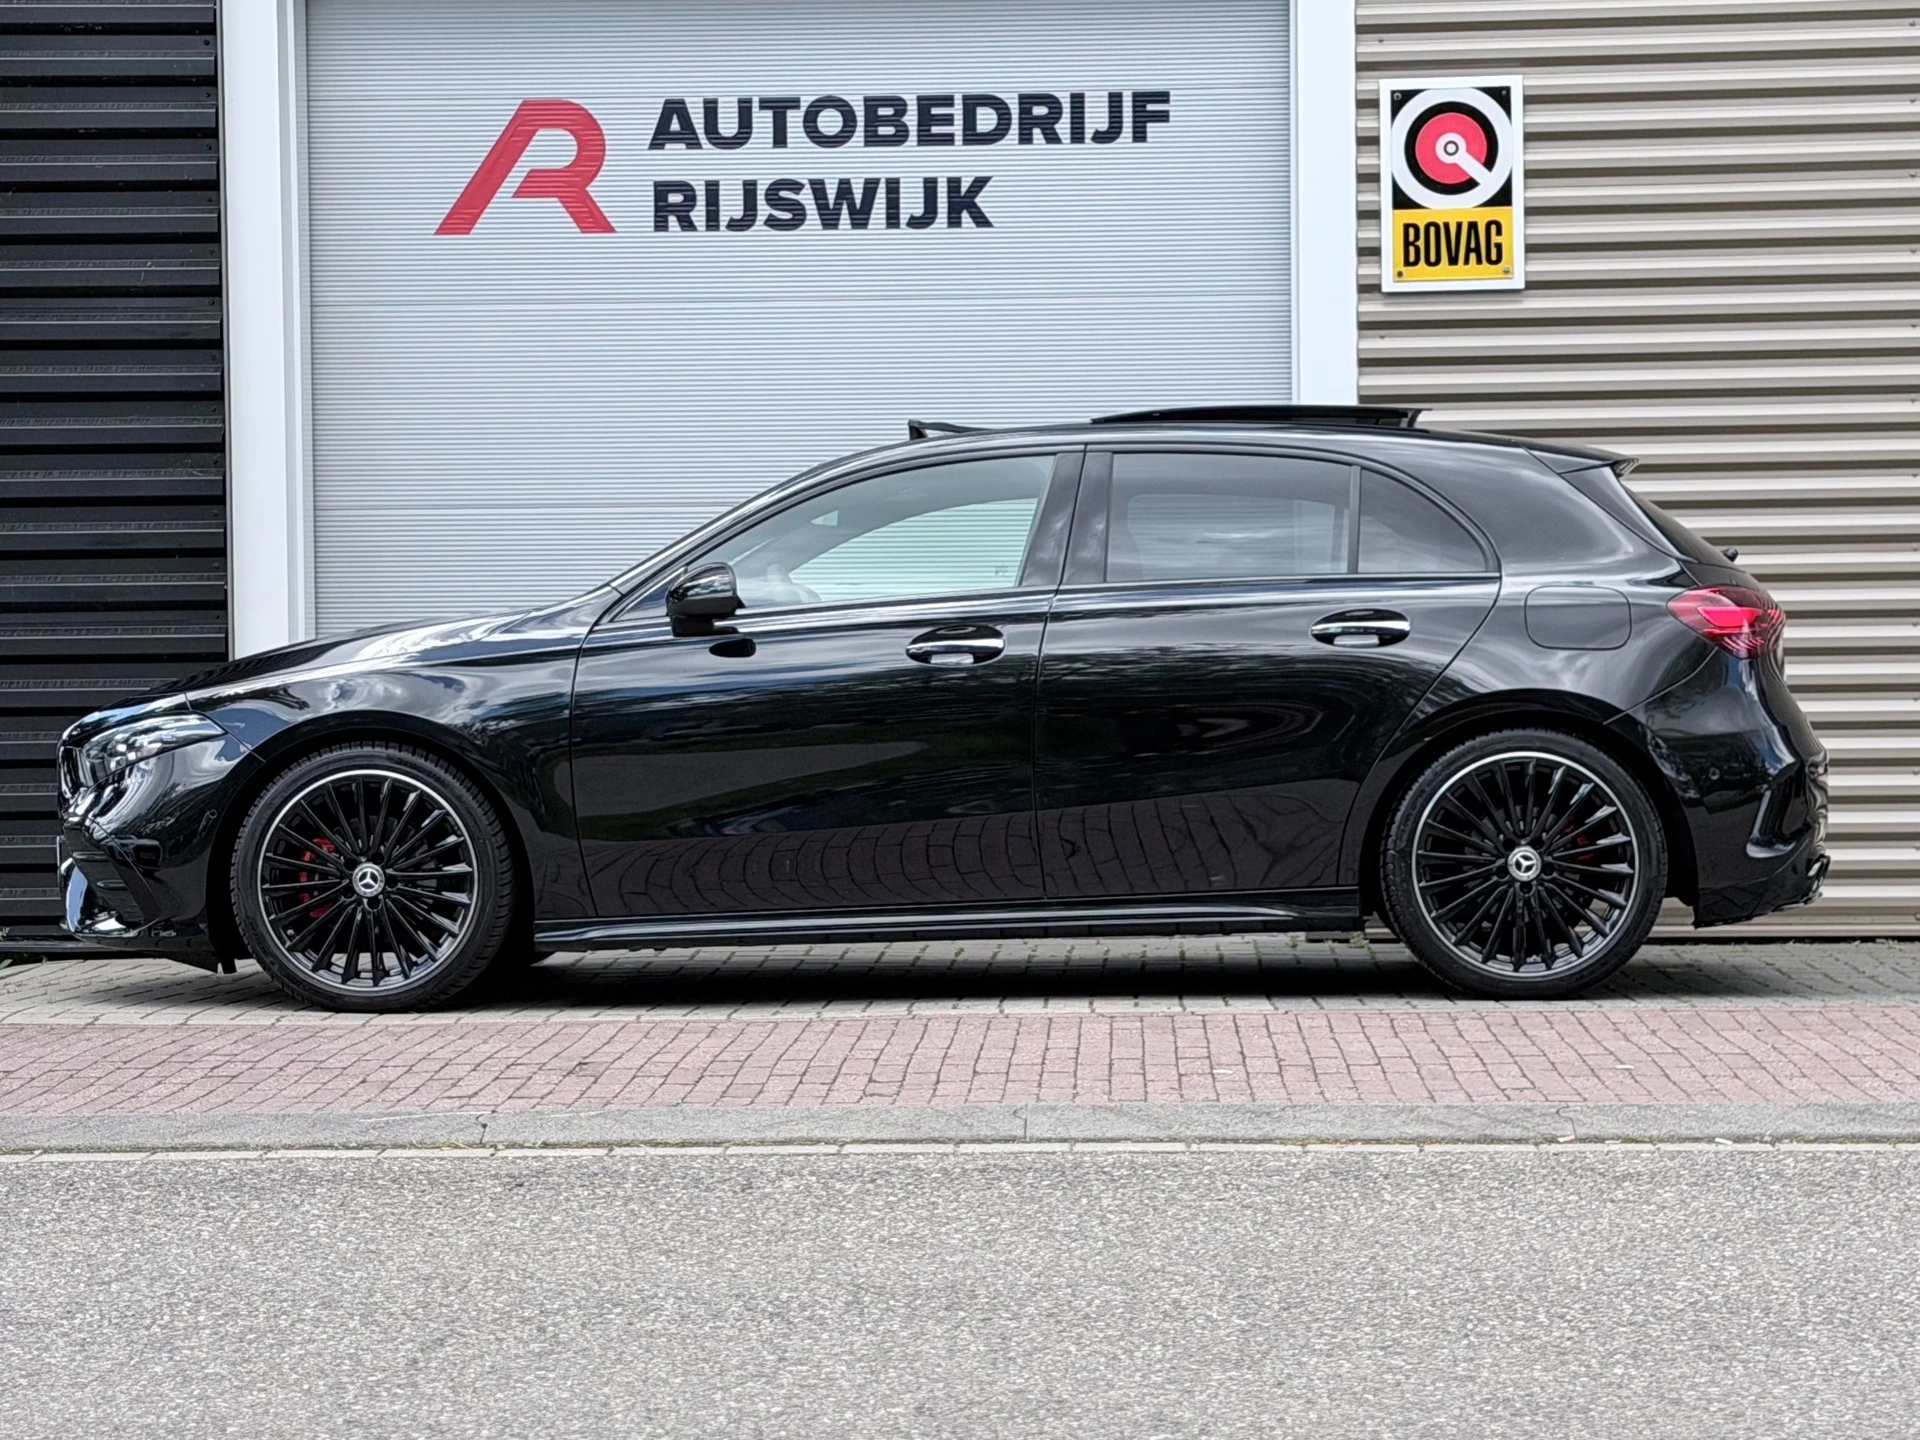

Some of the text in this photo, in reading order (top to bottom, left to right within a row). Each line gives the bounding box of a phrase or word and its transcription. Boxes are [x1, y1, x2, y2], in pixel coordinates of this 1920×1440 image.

[648, 90, 1171, 150] AUTOBEDRIJF
[652, 175, 994, 232] RIJSWIJK
[1403, 219, 1503, 267] BOVAG
